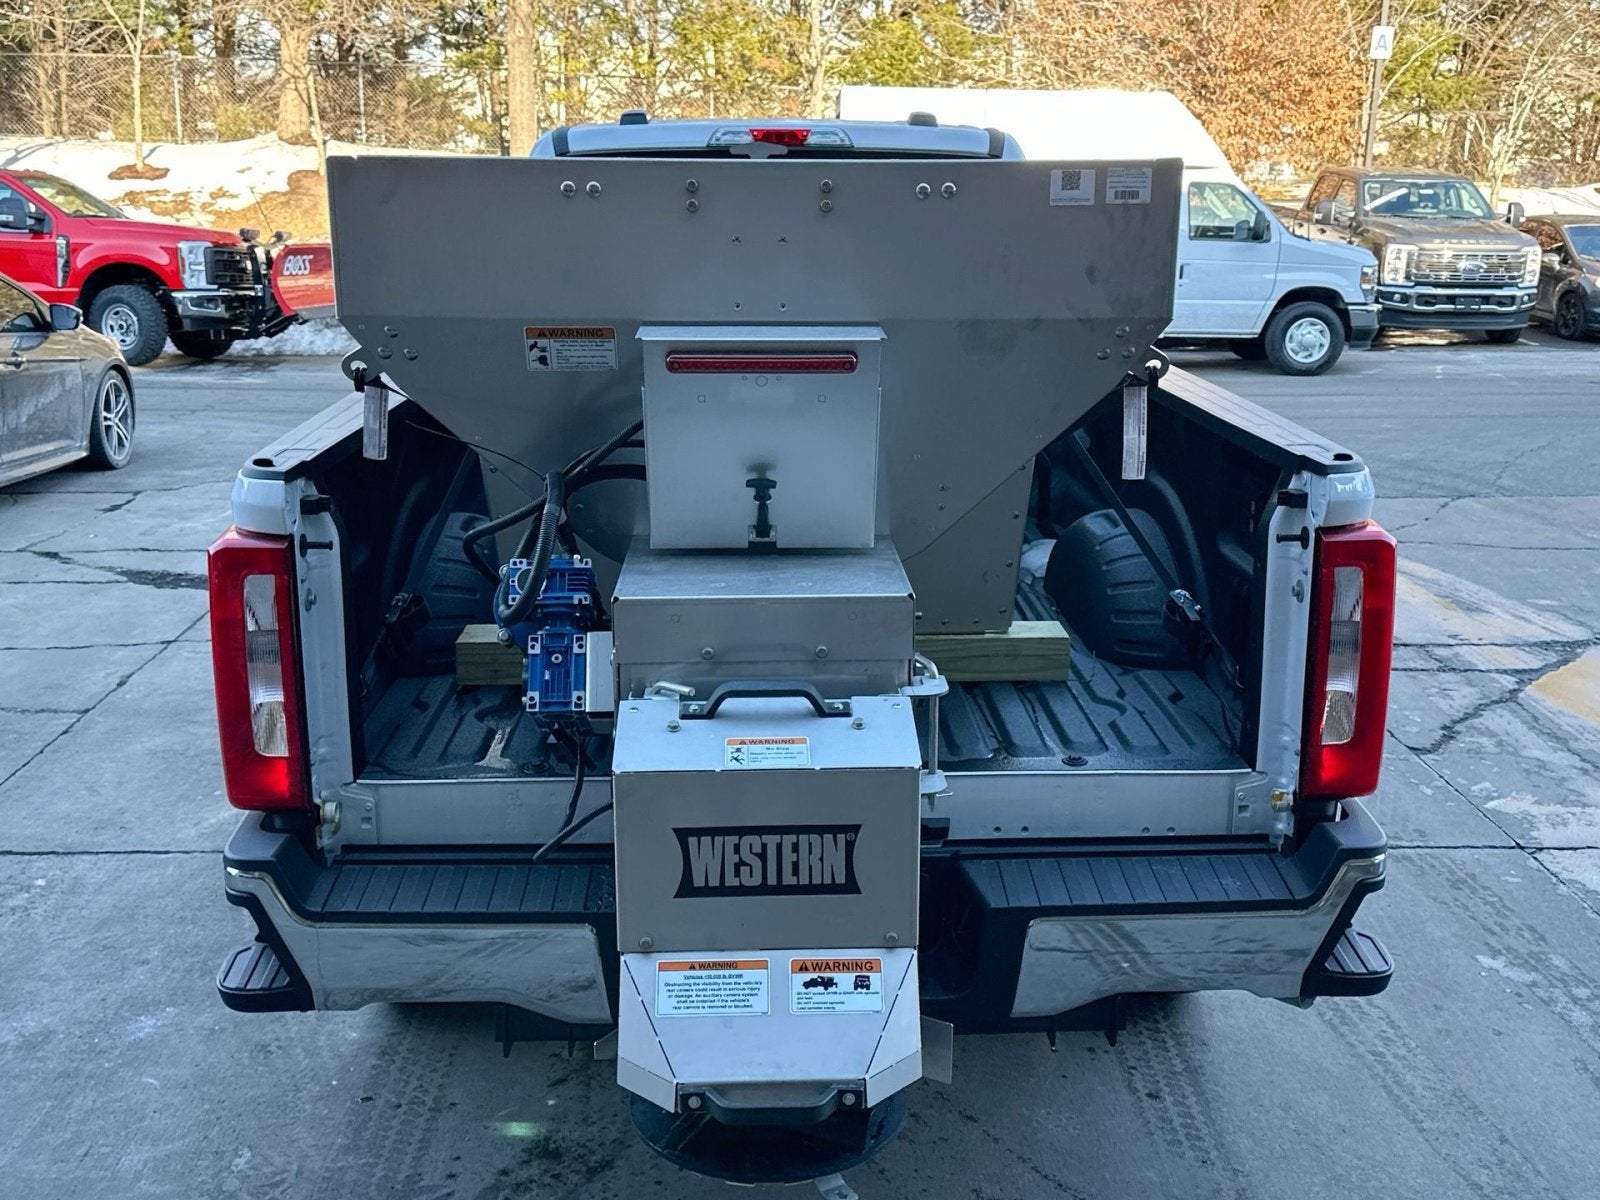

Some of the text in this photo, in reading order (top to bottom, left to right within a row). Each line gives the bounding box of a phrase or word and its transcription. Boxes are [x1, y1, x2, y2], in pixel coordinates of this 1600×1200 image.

[1375, 34, 1388, 51] A
[283, 255, 314, 276] BOSS
[548, 329, 604, 338] WARNING
[688, 834, 846, 887] WESTERN
[812, 961, 873, 971] WARNING
